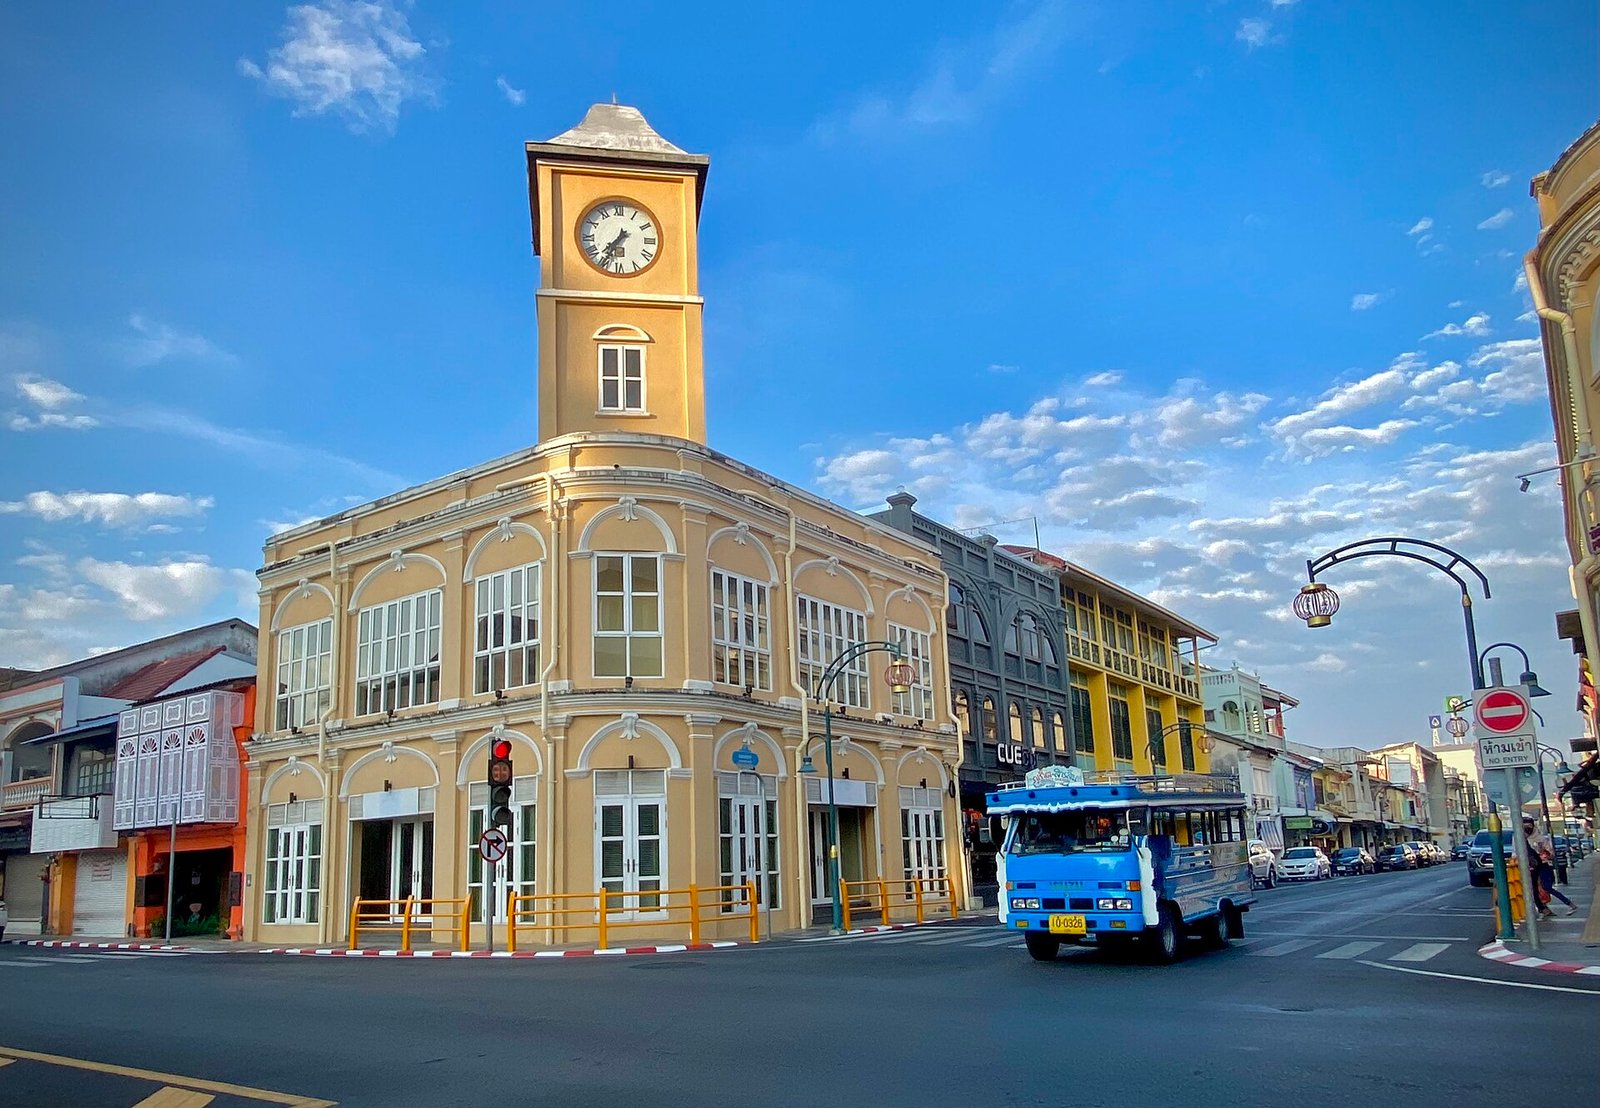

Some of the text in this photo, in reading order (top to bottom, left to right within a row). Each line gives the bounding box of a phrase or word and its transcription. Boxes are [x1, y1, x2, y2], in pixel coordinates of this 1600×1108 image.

[613, 205, 624, 216] XII
[586, 219, 599, 229] X
[1482, 737, 1532, 755] ห้ามเข้า
[1503, 755, 1528, 763] ENTRY
